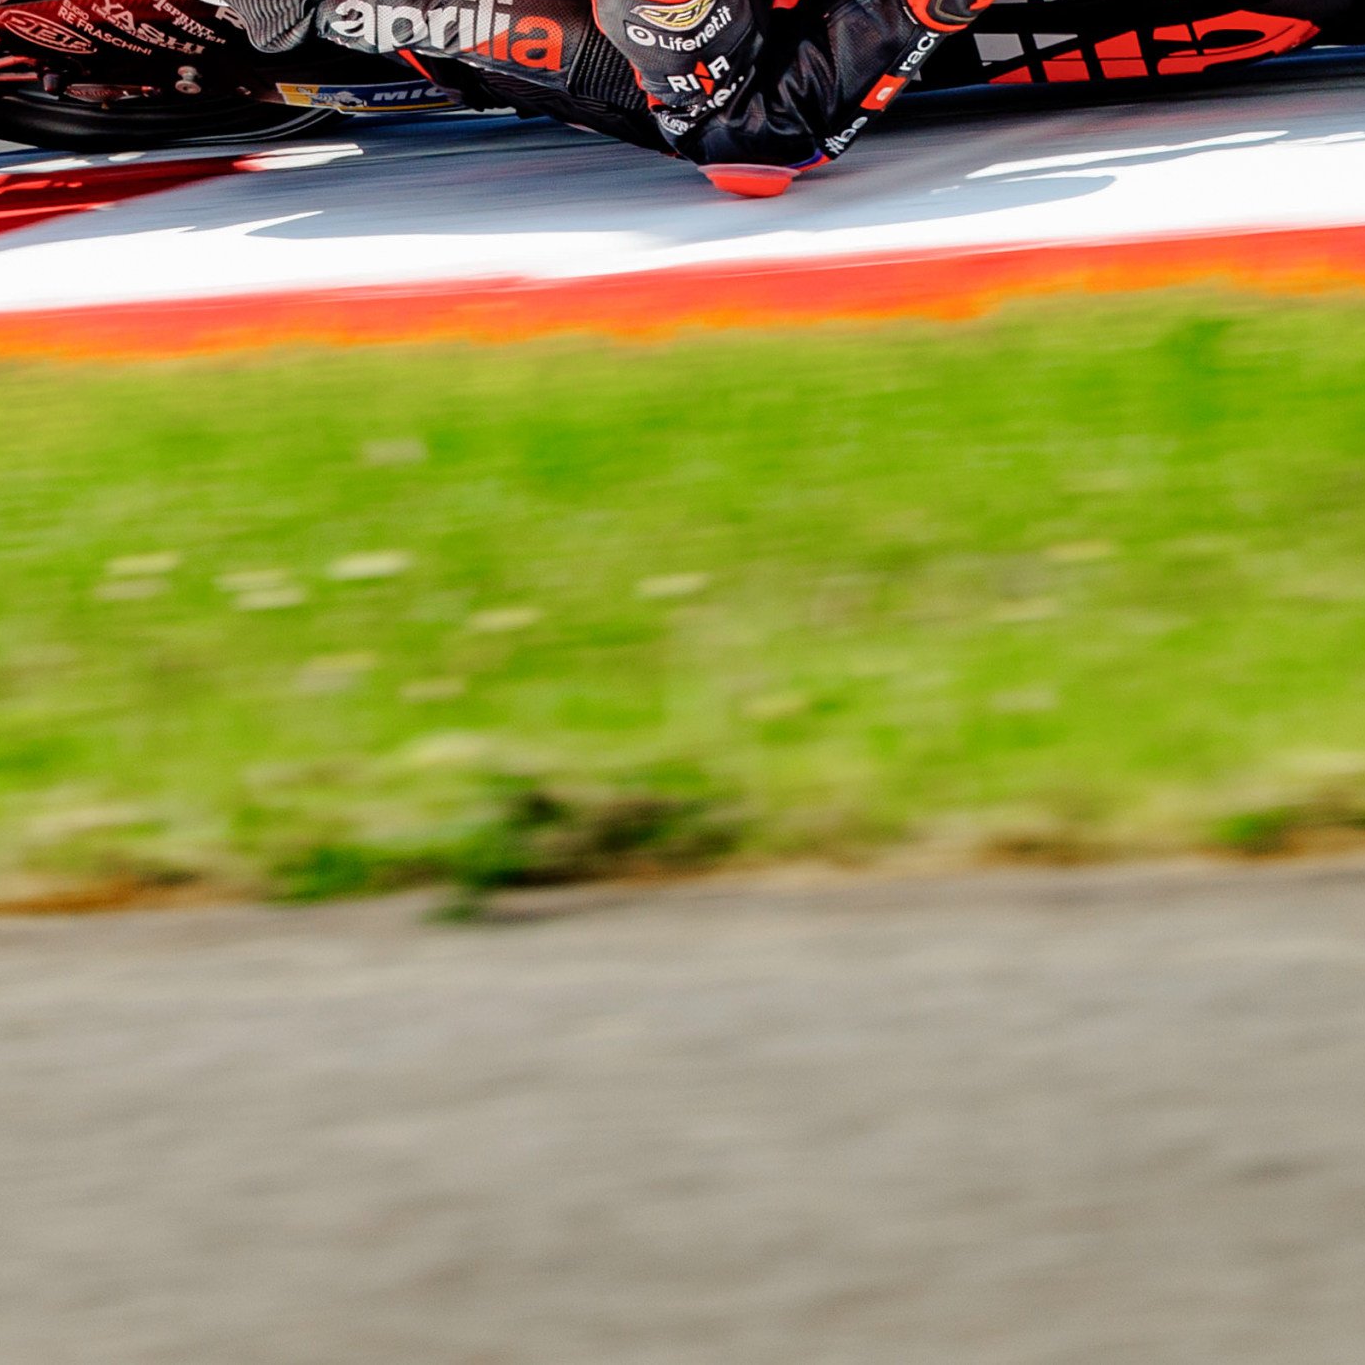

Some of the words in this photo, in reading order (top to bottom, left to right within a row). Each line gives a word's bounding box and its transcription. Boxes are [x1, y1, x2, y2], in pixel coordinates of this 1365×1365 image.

[56, 8, 80, 30] RE
[76, 20, 153, 56] FRASCHINI
[162, 1, 216, 37] SPRINT
[658, 4, 732, 53] Lifenet.it
